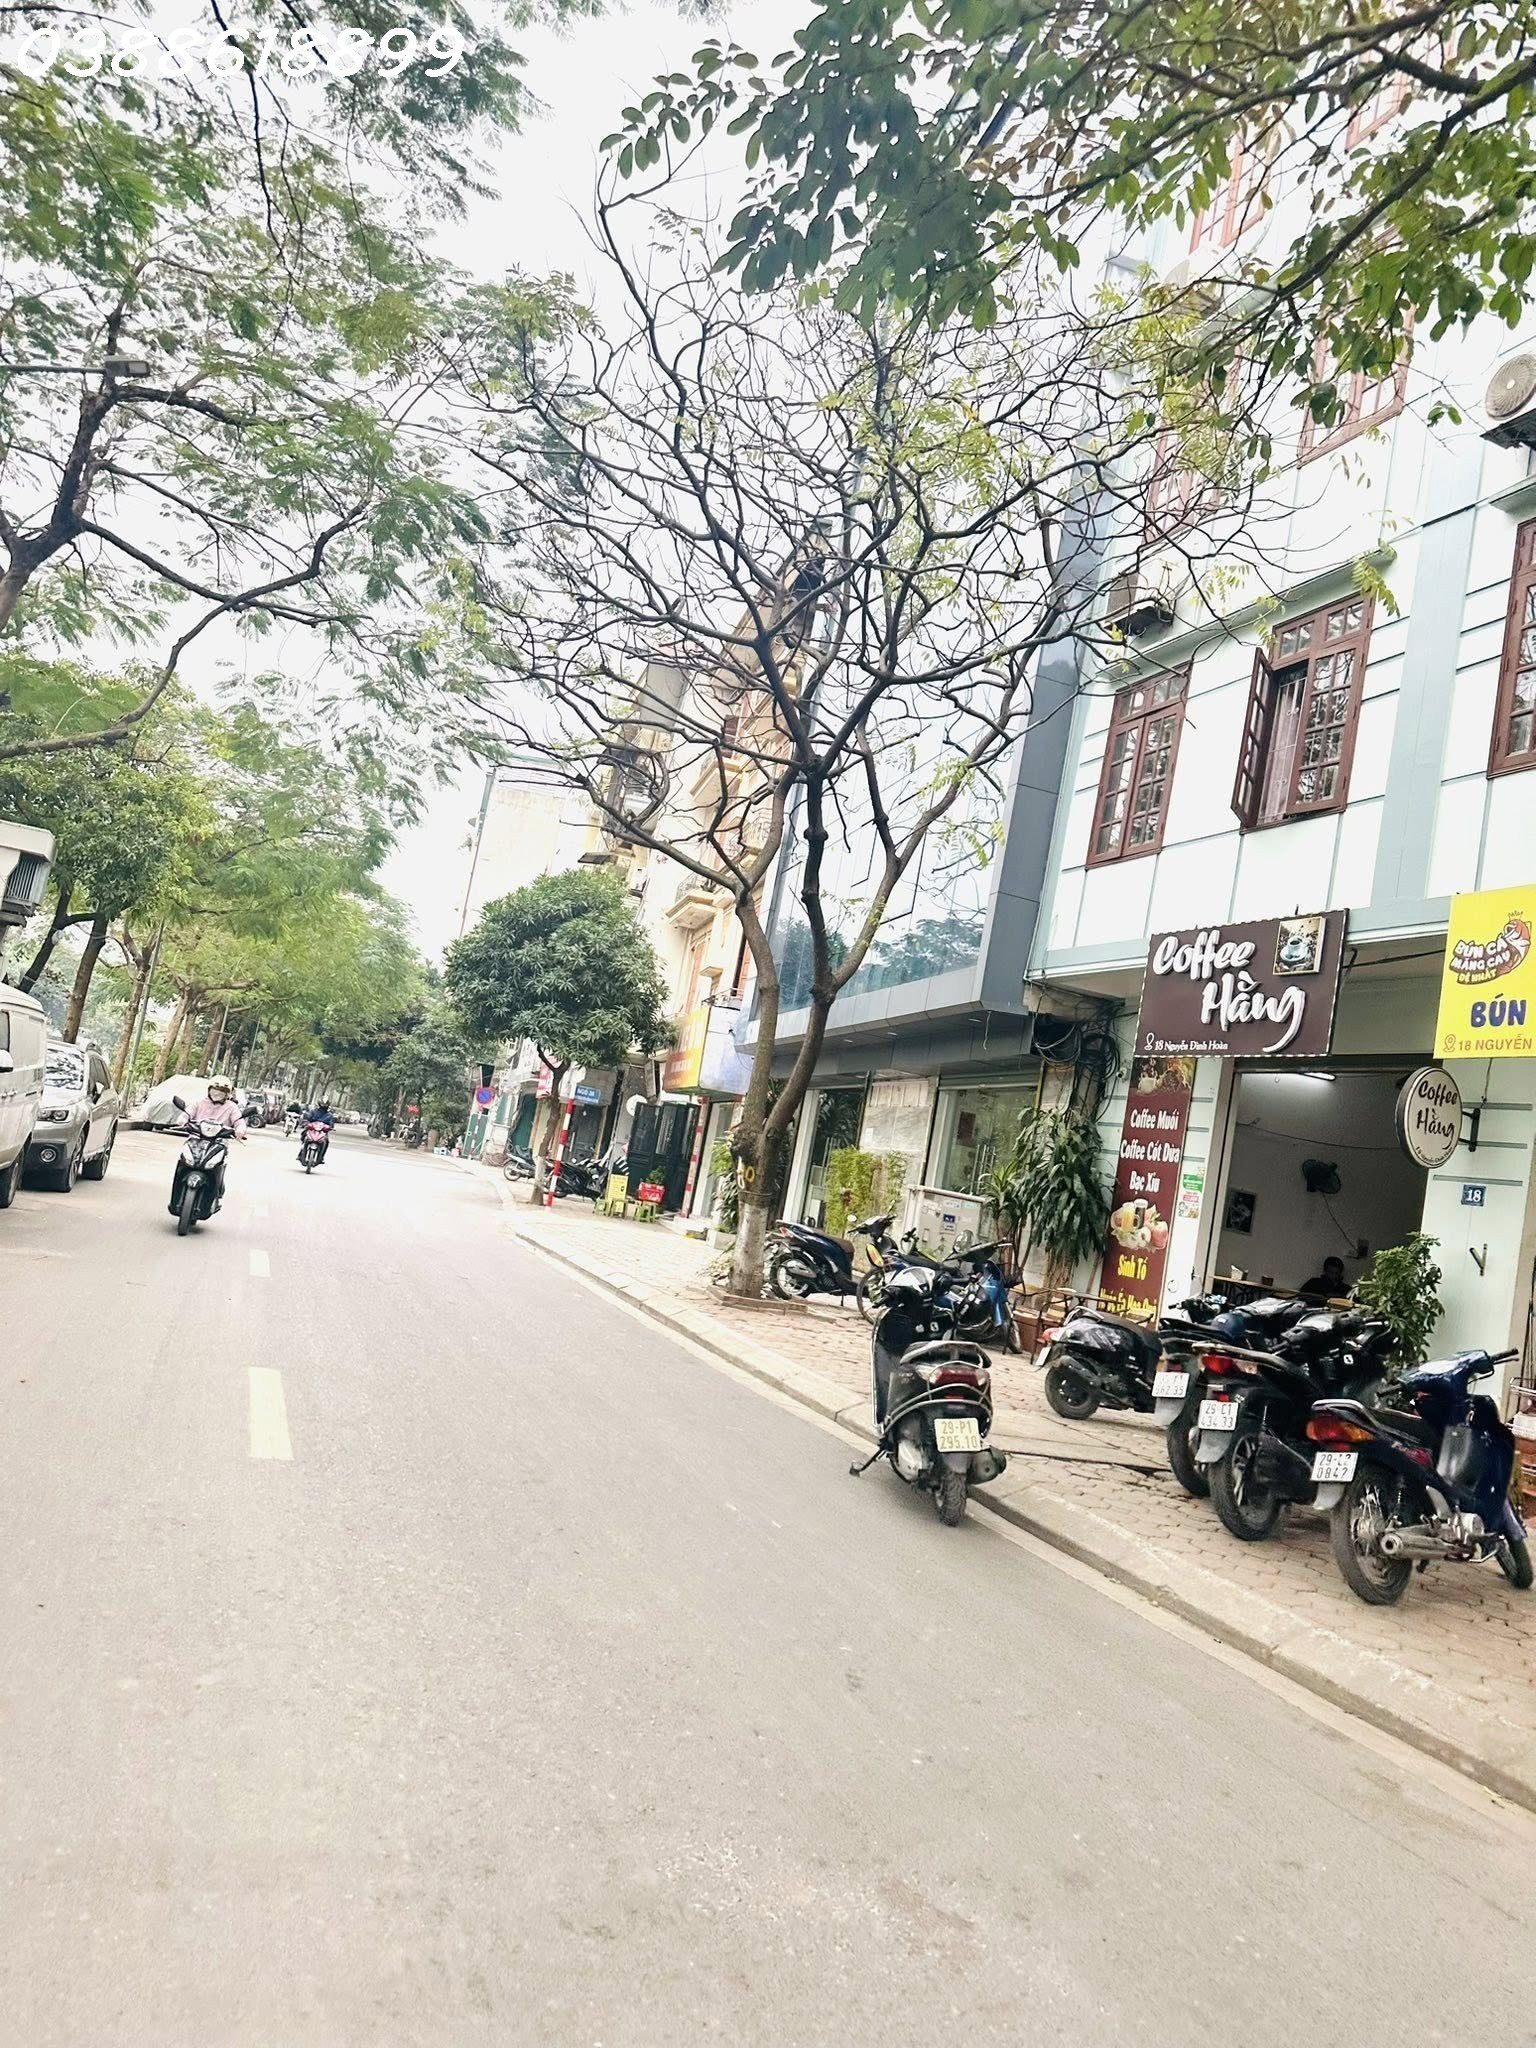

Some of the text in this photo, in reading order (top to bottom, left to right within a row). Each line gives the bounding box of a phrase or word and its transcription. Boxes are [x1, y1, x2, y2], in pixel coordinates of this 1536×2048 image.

[1152, 929, 1256, 981] Coffee
[1201, 970, 1306, 1053] Hằng
[1470, 993, 1527, 1028] BÚN
[1154, 1040, 1164, 1051] 18
[1459, 1040, 1471, 1051] 18
[1418, 1080, 1458, 1107] Coffee
[1130, 1108, 1156, 1129] Coffee
[1416, 1107, 1455, 1150] Hằng
[1120, 1139, 1145, 1160] Coffee
[1466, 1189, 1482, 1203] 18
[941, 1421, 972, 1434] 29-P1
